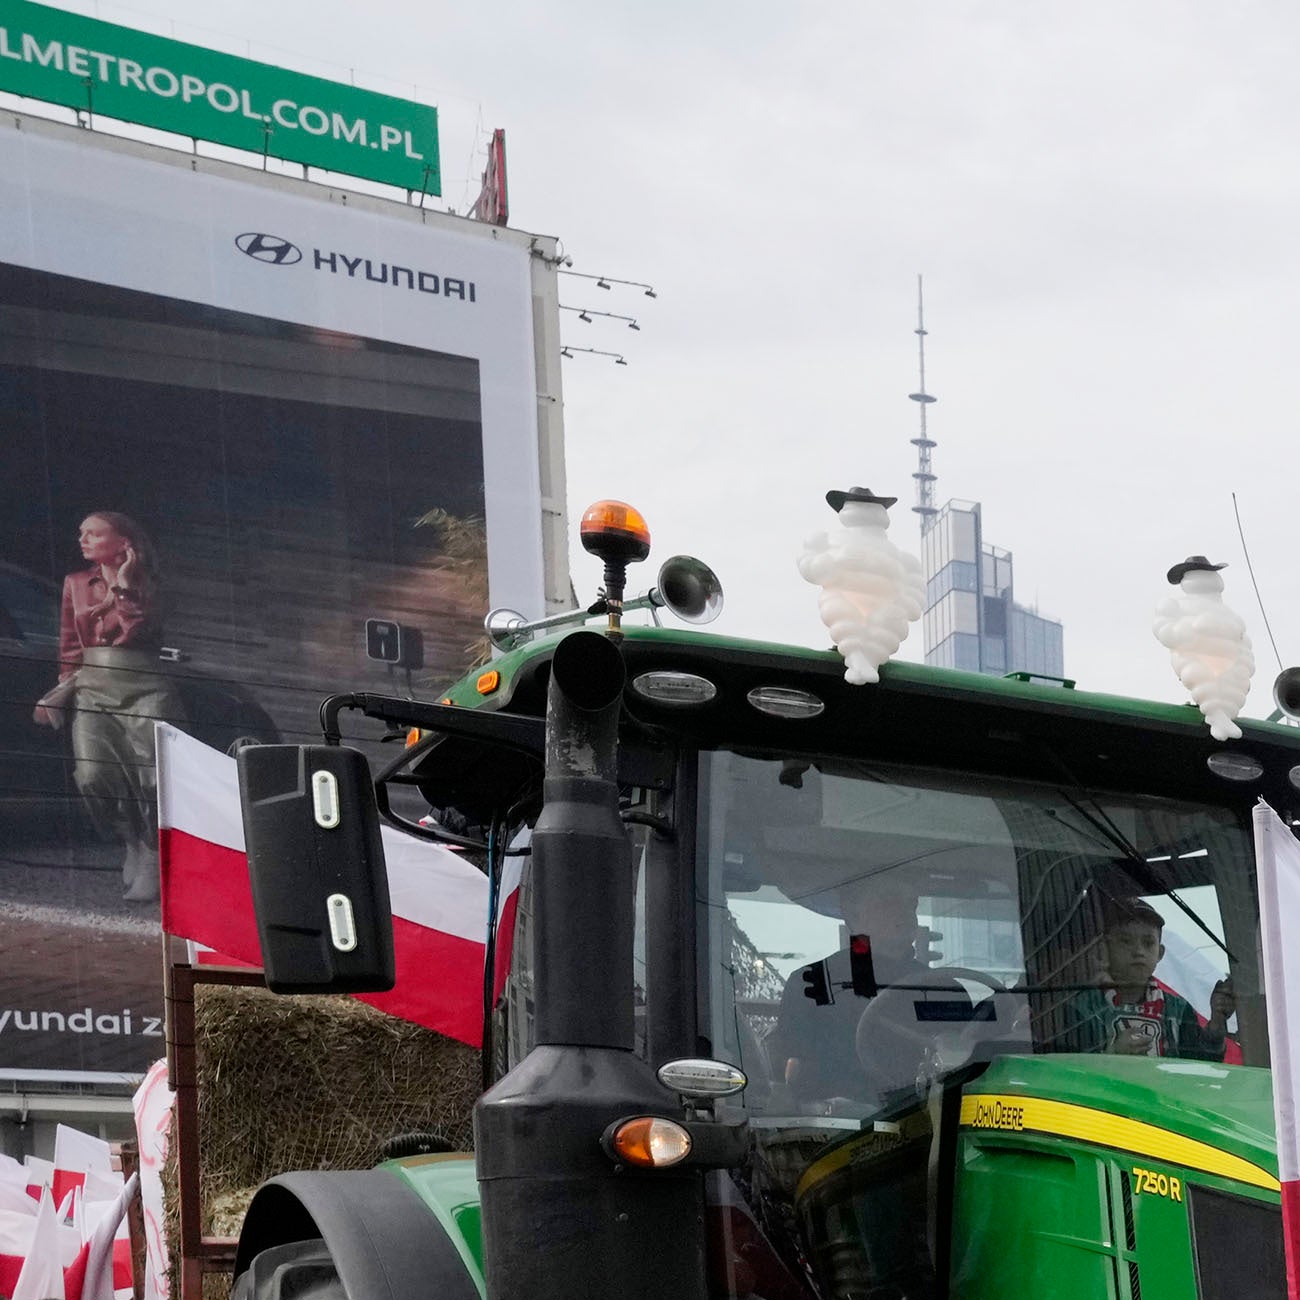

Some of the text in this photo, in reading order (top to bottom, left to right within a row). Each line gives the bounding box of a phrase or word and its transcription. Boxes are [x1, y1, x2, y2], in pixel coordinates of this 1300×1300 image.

[0, 27, 424, 161] LMETROPOL.COM.PL
[313, 248, 476, 302] HYUNDAI
[142, 1016, 168, 1036] z
[1133, 1167, 1182, 1202] 7250 R
